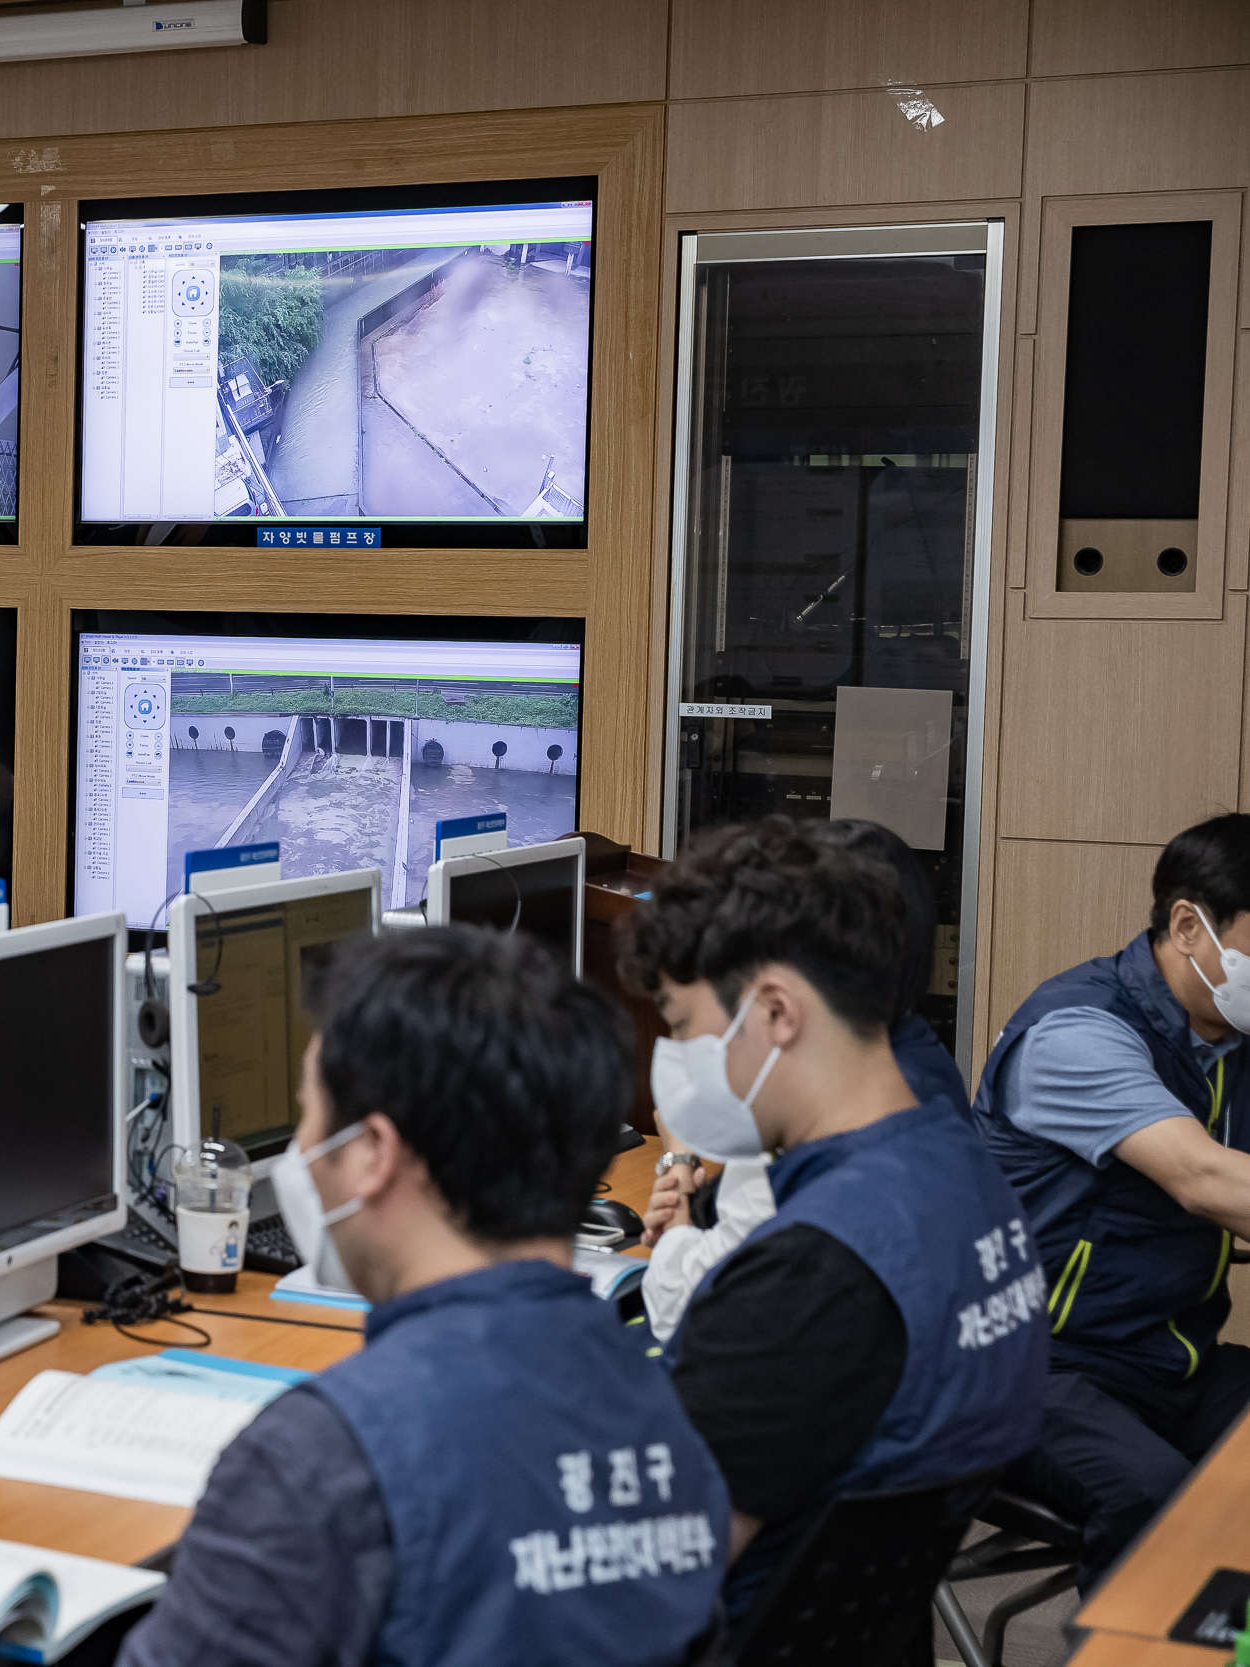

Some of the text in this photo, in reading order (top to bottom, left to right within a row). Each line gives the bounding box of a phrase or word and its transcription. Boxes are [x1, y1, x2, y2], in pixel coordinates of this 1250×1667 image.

[262, 531, 375, 545] 자양빗물펌프장
[686, 706, 766, 716] 관계자외 조작금지
